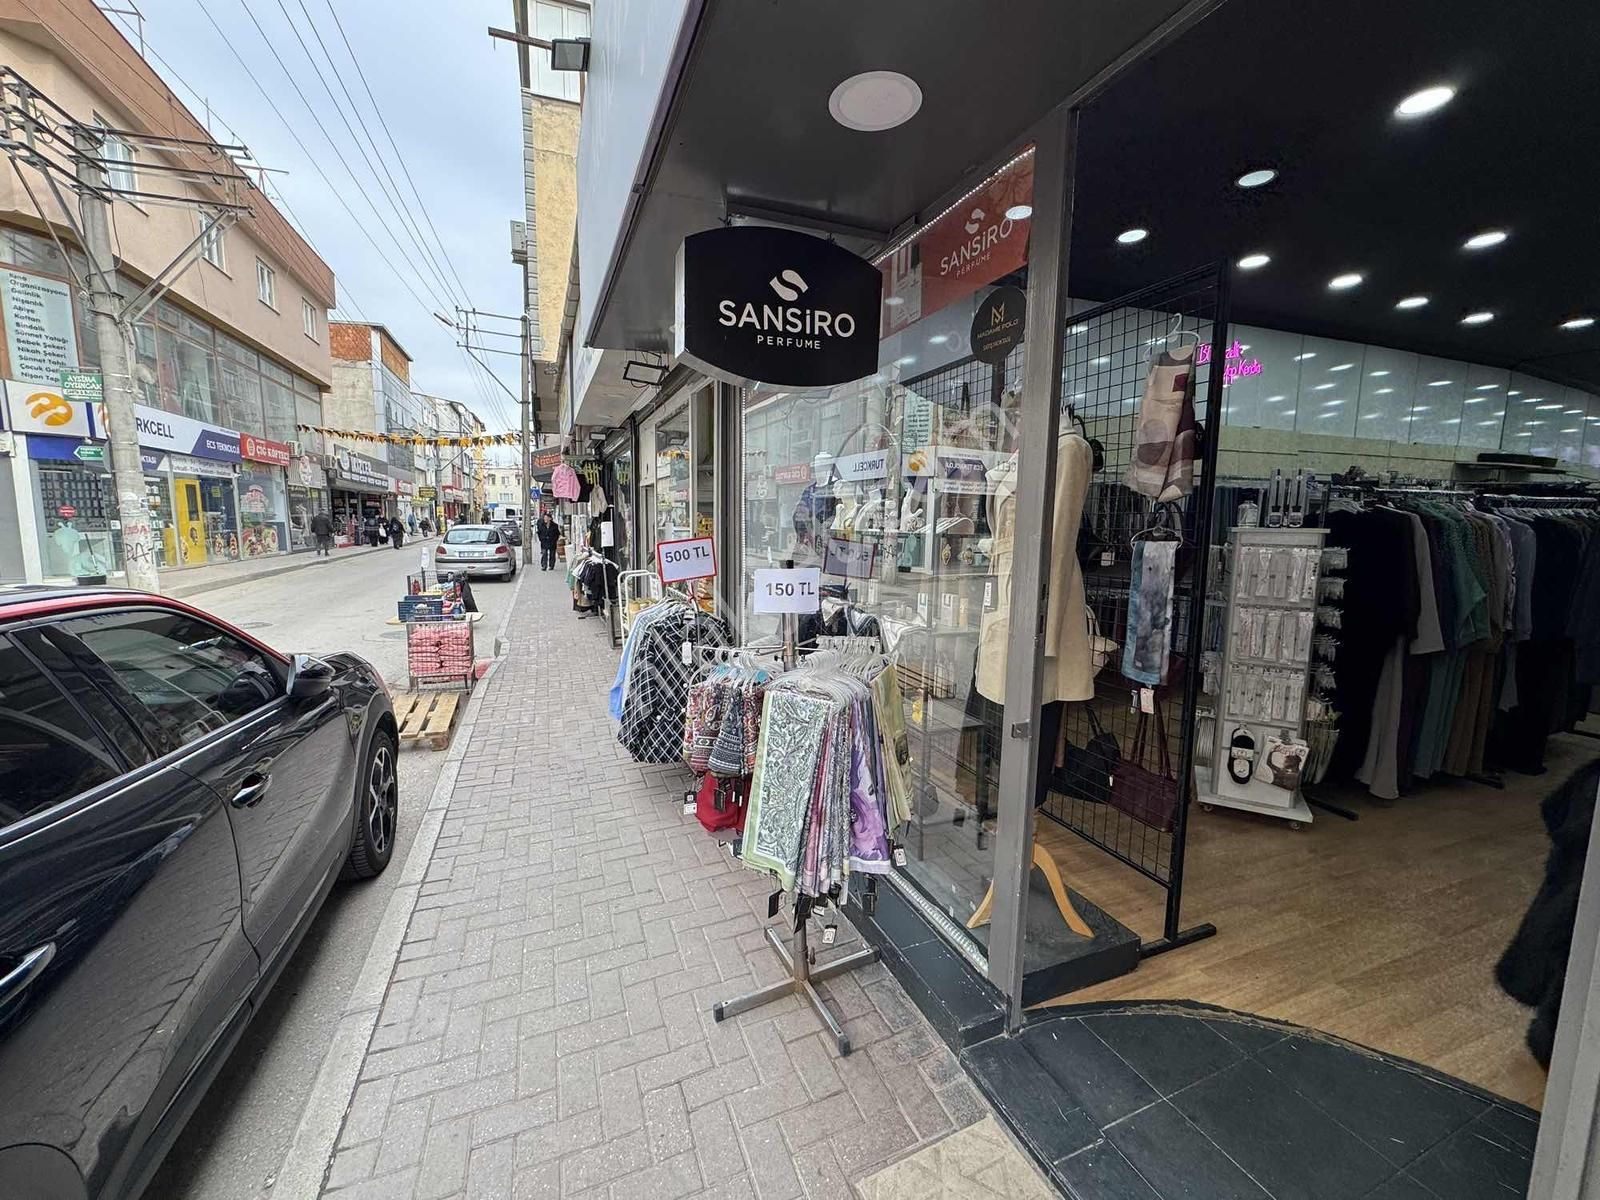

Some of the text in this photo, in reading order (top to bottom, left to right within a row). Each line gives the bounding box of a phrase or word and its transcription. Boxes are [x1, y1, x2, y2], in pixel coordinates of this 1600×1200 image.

[956, 252, 991, 278] PERFUME
[13, 305, 35, 315] Abiye
[17, 338, 41, 347] Bebek
[757, 335, 821, 349] PERFUME
[665, 546, 710, 564] 500 TL
[765, 582, 815, 597] 150 TL
